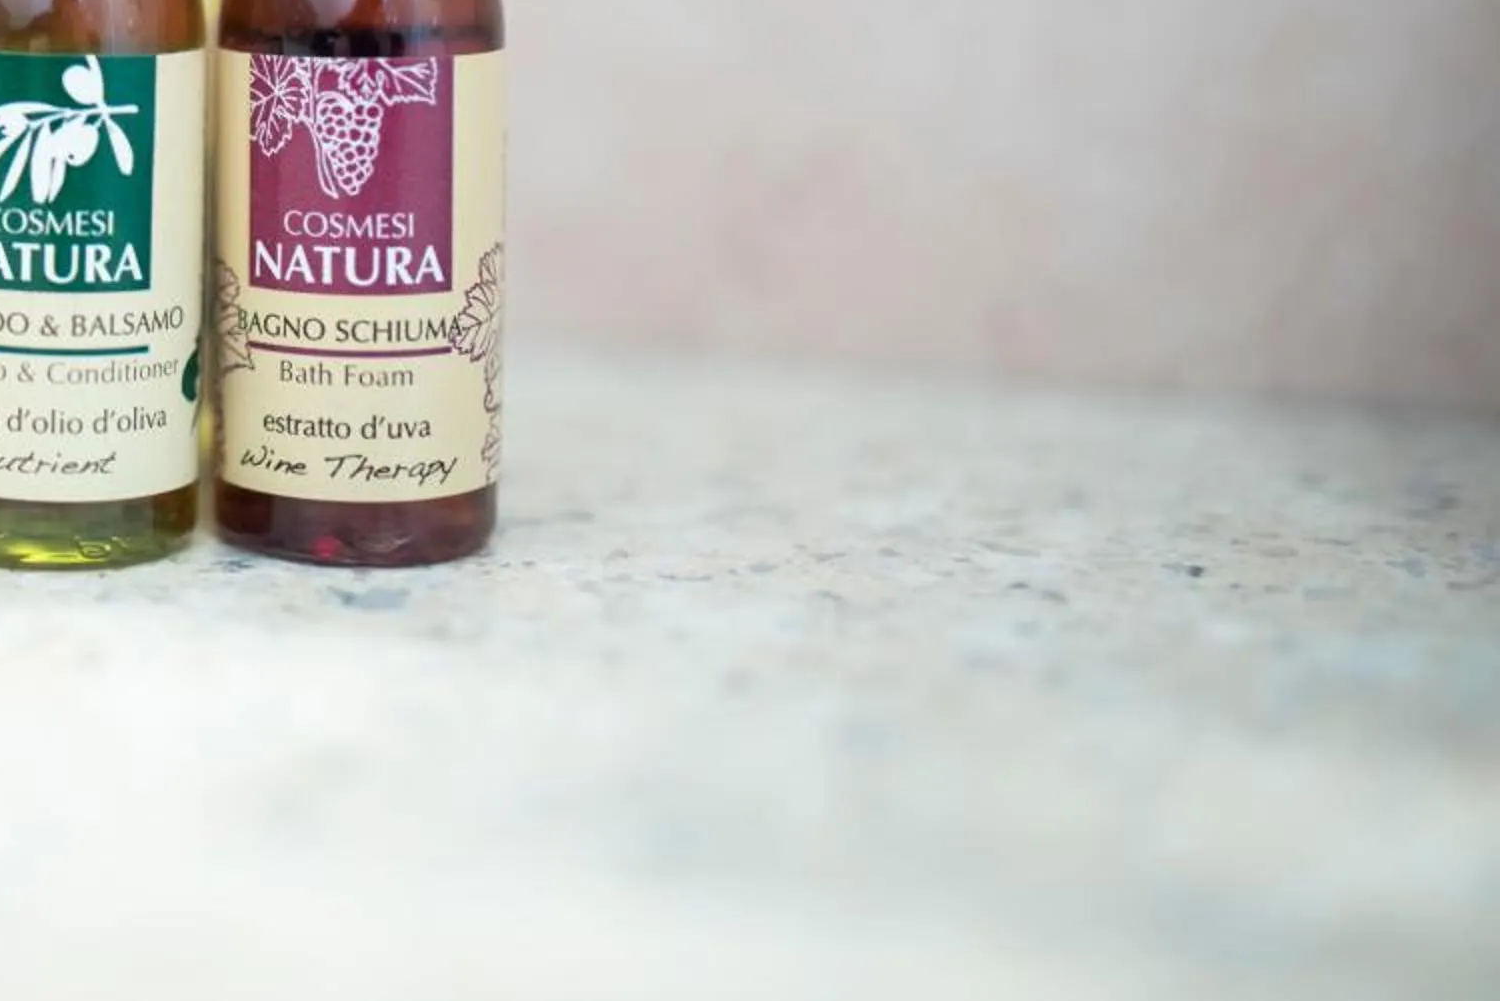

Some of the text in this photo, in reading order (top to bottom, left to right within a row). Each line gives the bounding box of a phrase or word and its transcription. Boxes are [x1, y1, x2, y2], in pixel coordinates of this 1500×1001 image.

[283, 209, 415, 239] COSMESI
[254, 239, 445, 286] NATURA
[40, 314, 59, 337] &
[71, 305, 184, 338] BALSAMO
[237, 310, 463, 343] BAGNO SCHIUMA
[17, 362, 36, 384] &
[46, 357, 180, 385] Conditioner
[279, 359, 415, 388] Bath Foam
[7, 408, 84, 436] d'olio
[93, 407, 168, 436] d'oliva
[263, 413, 431, 441] estratto d'uva
[239, 445, 459, 487] Wine Therapy
